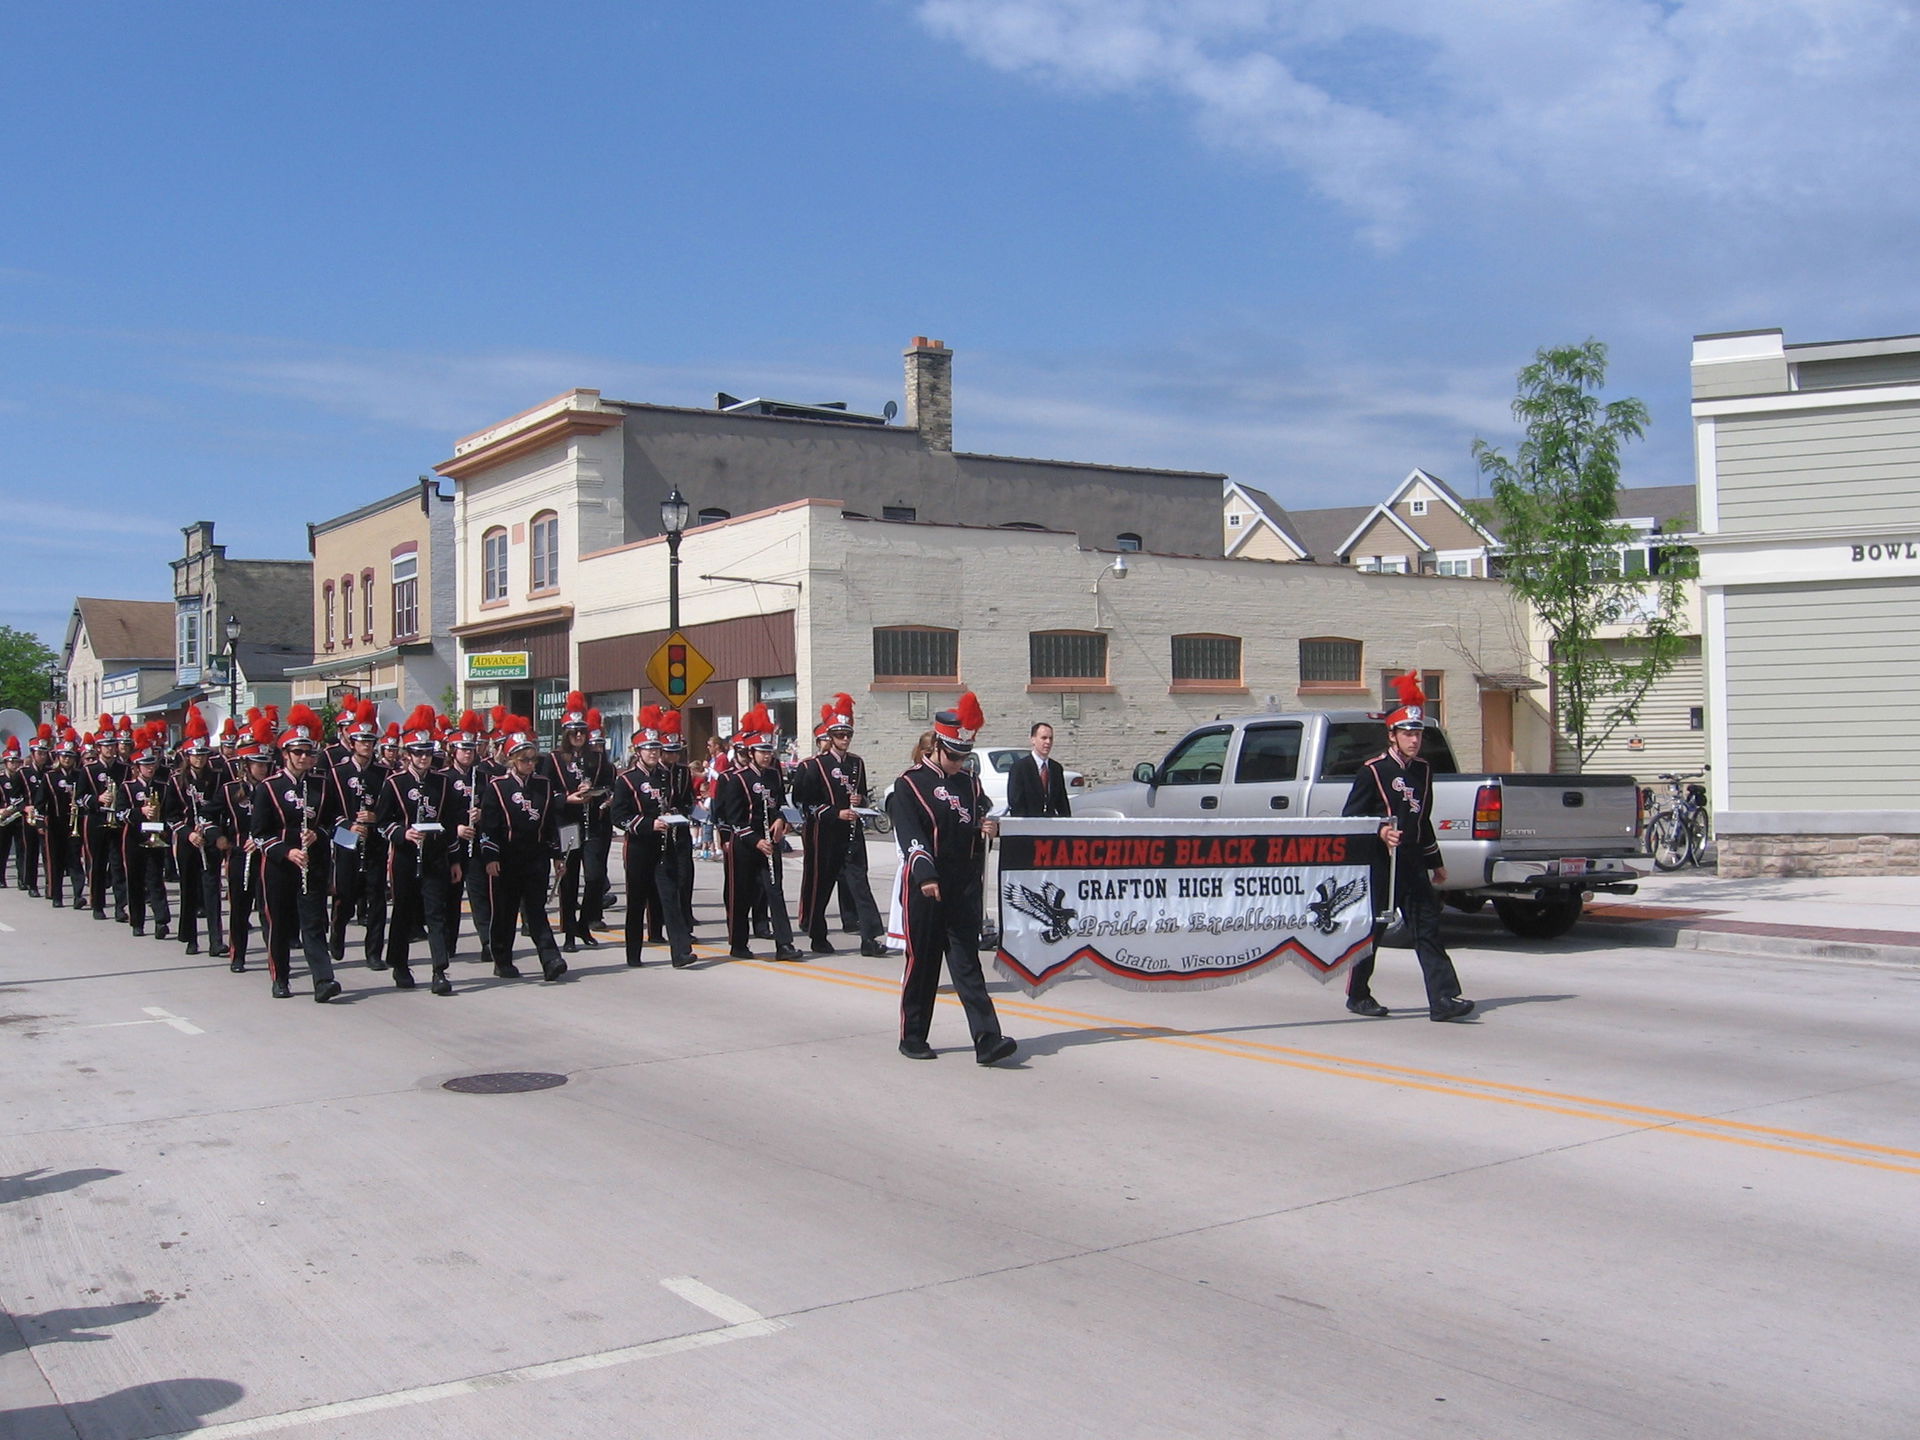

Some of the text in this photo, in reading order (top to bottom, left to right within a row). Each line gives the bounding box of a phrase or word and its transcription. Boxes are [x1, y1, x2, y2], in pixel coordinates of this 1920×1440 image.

[470, 668, 520, 677] PAYCHECKS
[474, 656, 518, 666] ADVANCE
[1438, 820, 1470, 831] Z71
[1033, 837, 1346, 867] MARCHING BLACK HAWKS
[1078, 876, 1305, 901] GRAFTON HIGH SCHOOL
[1077, 907, 1308, 937] Pride in Excellence
[1180, 946, 1262, 969] Wisconsin
